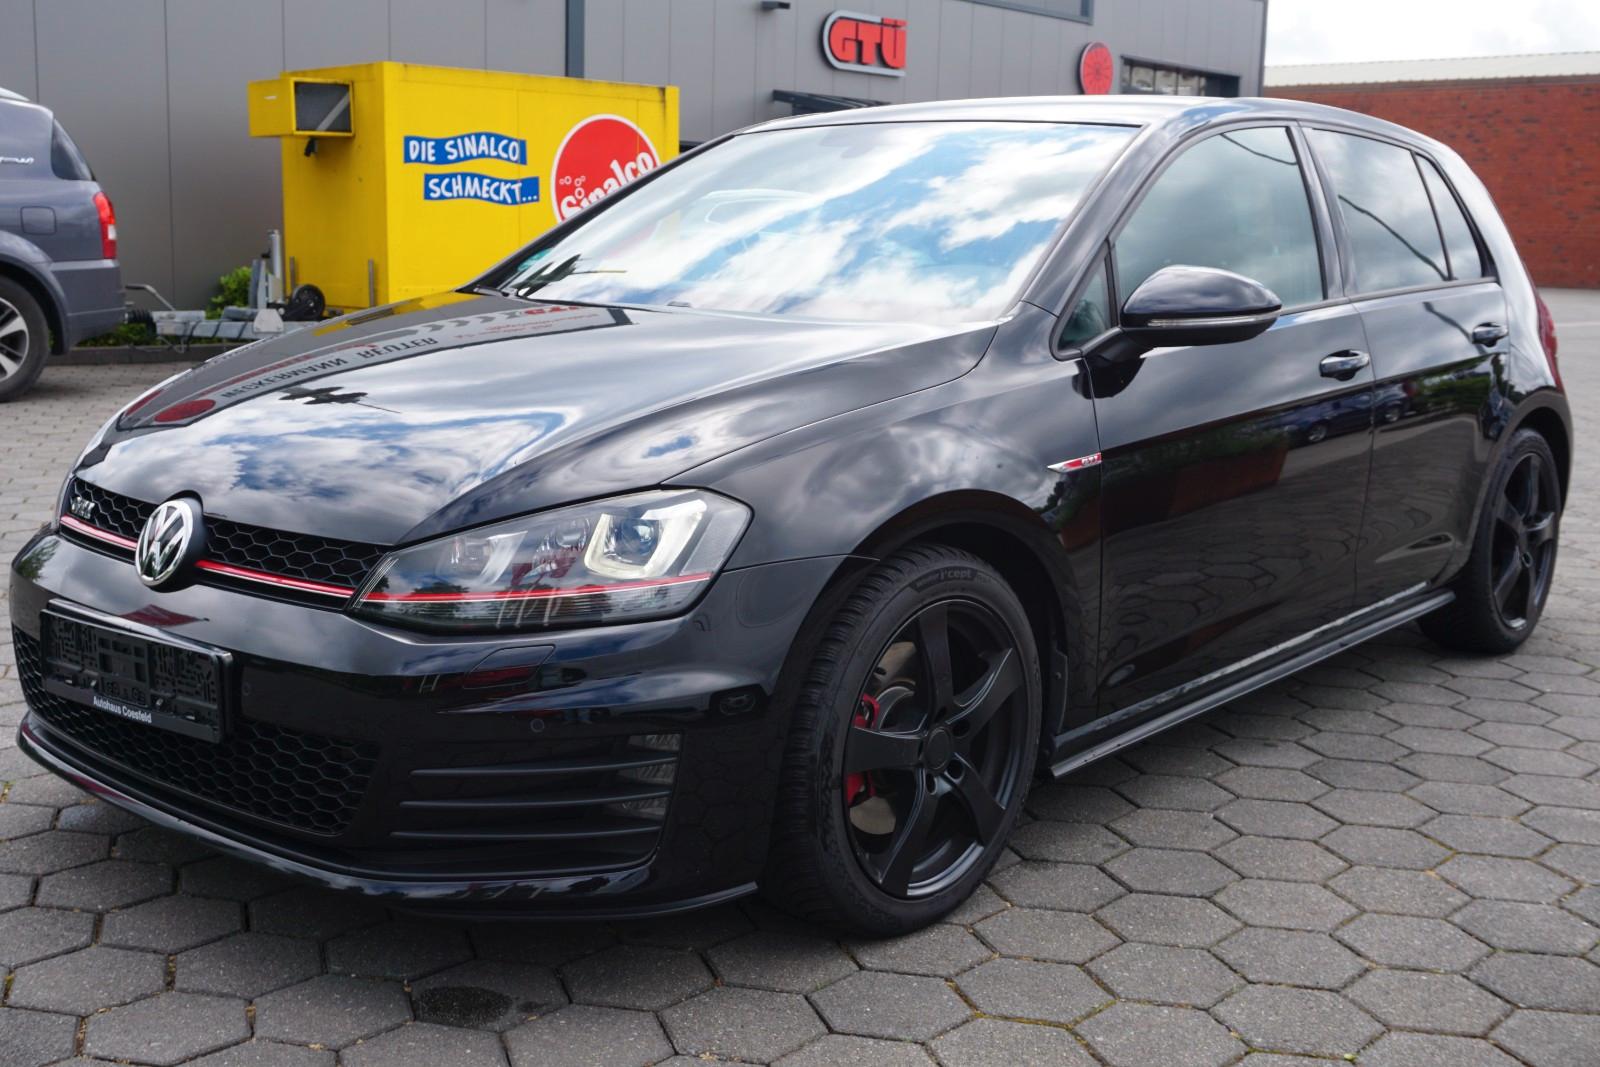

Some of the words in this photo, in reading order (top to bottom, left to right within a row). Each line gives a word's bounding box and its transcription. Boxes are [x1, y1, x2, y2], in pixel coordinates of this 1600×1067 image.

[830, 17, 907, 69] GTÜ
[408, 140, 436, 162] DIE
[444, 135, 520, 162] SINALCO
[428, 174, 538, 204] SCHMECKT...
[93, 695, 122, 715] Autohaus
[122, 705, 152, 724] Coesfeld
